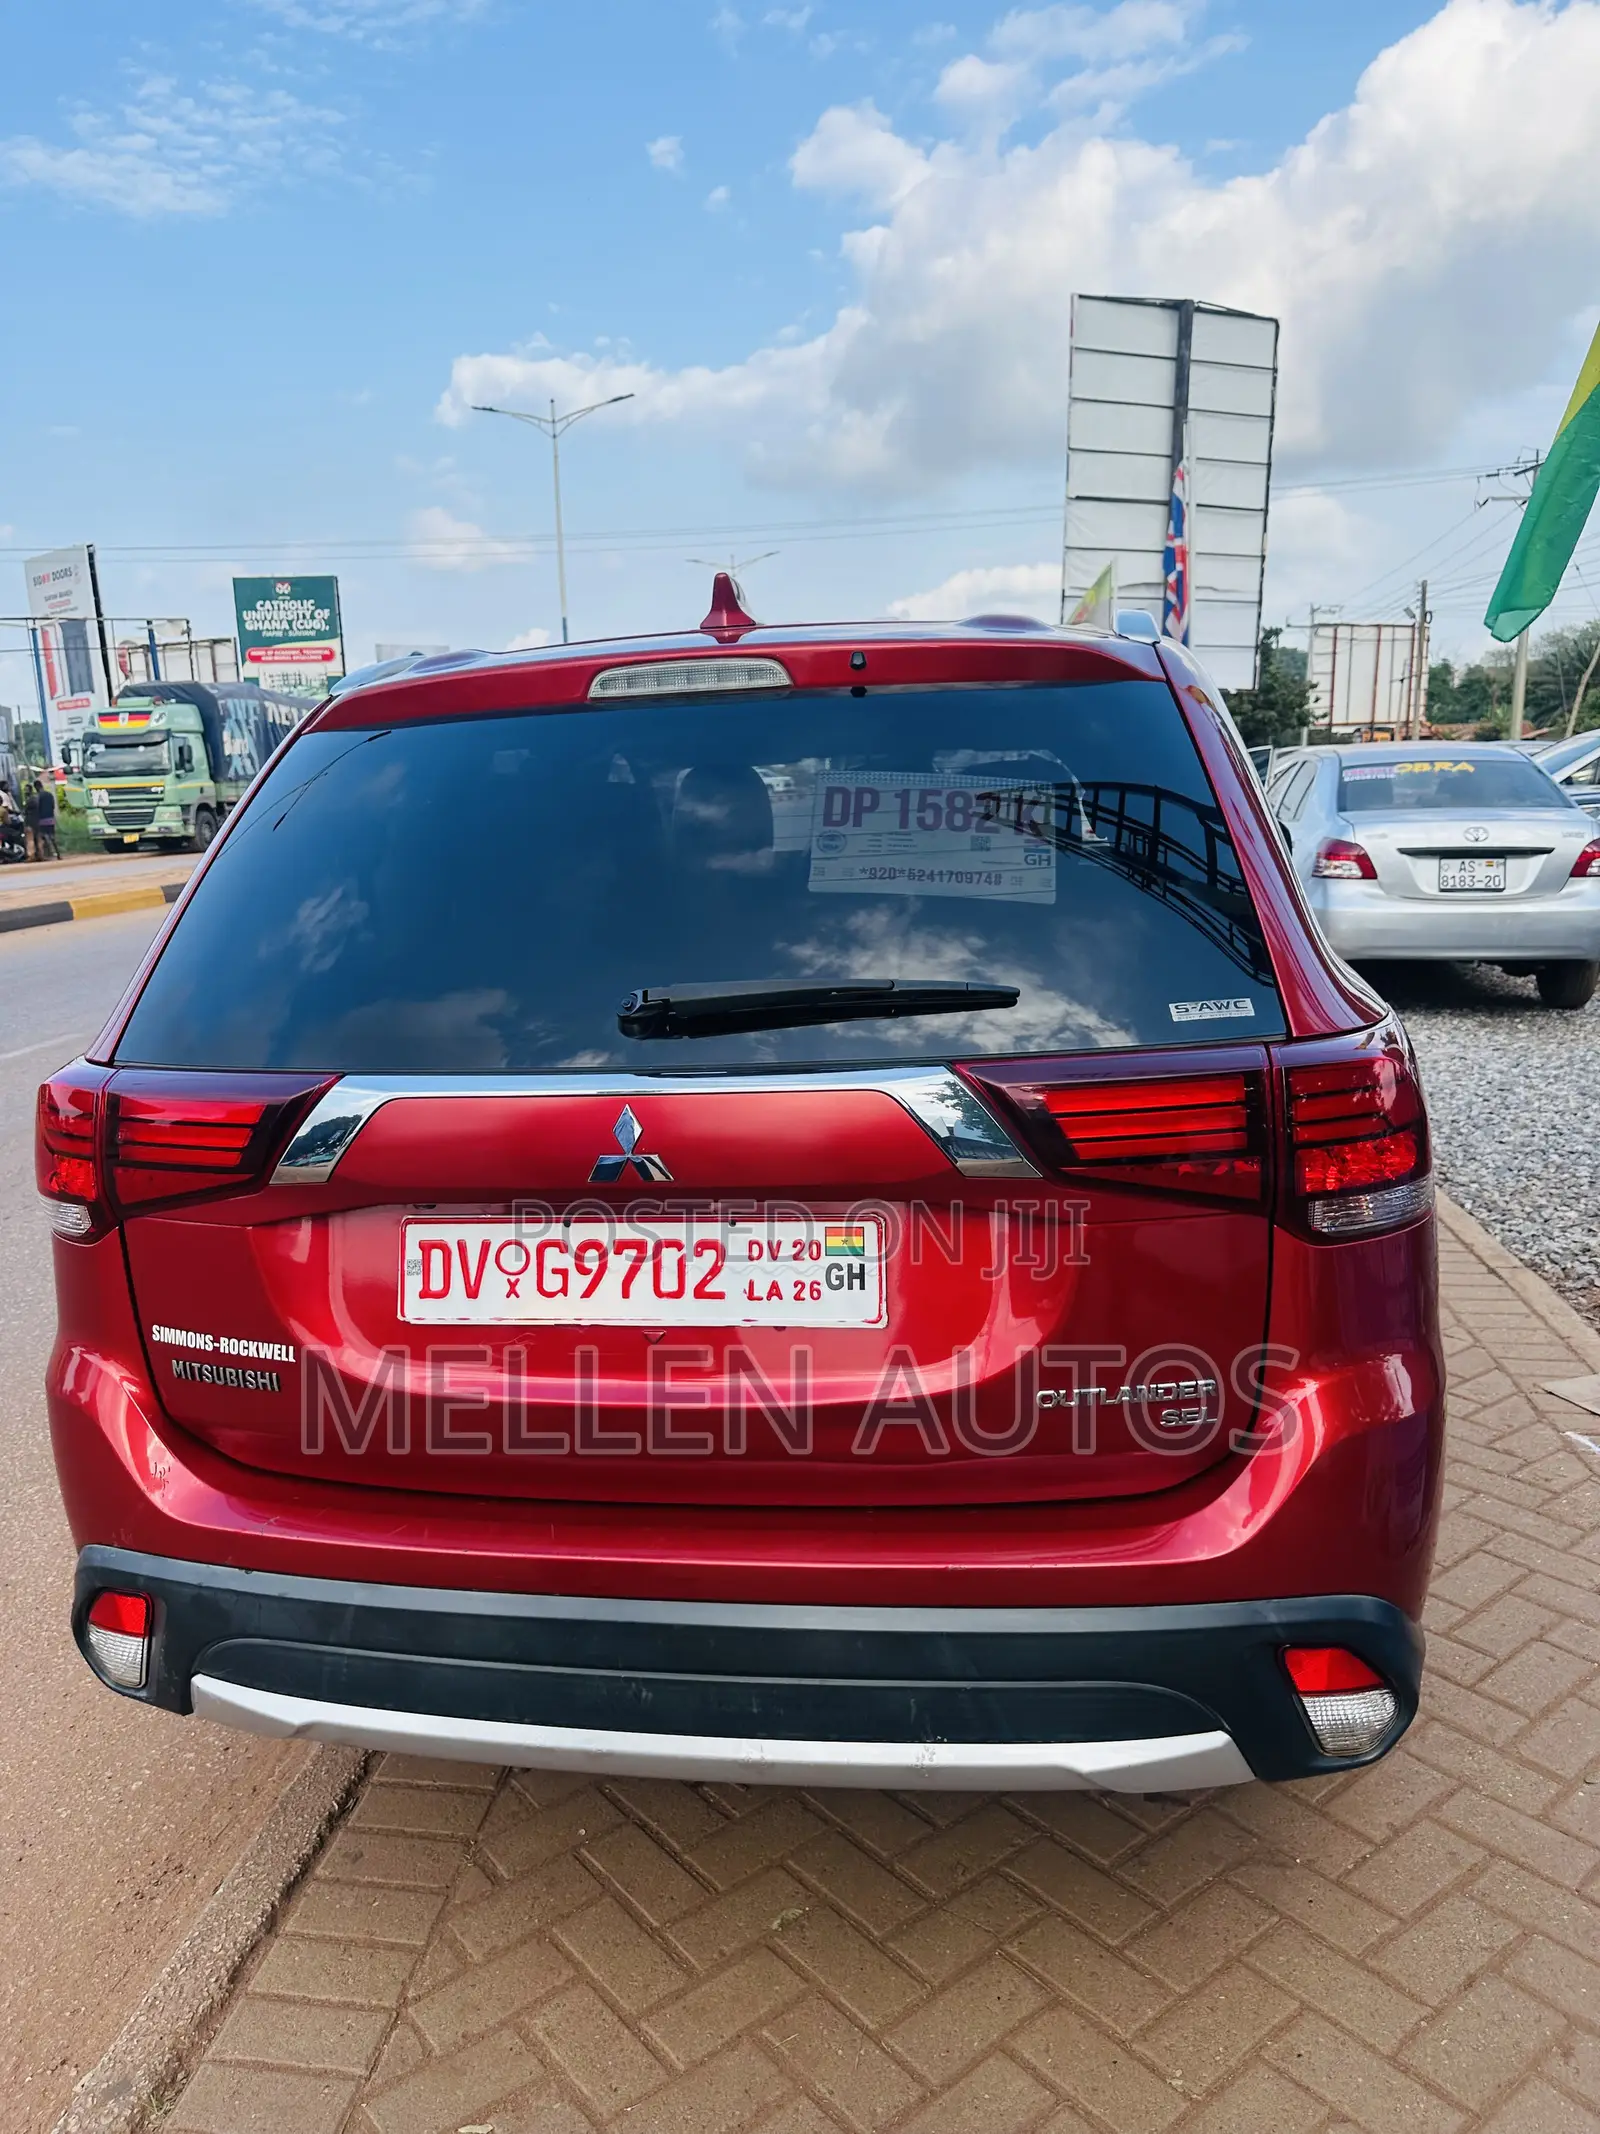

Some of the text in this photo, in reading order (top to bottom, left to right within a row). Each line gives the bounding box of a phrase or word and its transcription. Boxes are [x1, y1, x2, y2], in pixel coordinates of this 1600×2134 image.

[242, 608, 330, 620] UNIVERSITY OF
[256, 600, 315, 611] CATHOLIC
[245, 620, 290, 630] GHANA
[822, 785, 880, 828] DP
[893, 786, 1000, 834] 1582
[1023, 853, 1051, 866] GH
[1458, 860, 1476, 874] AS
[1441, 875, 1502, 888] 8183-20
[1174, 1000, 1249, 1014] S-AWC
[747, 1238, 822, 1262] DV 20
[418, 1238, 726, 1300] DV G9702
[825, 1262, 866, 1291] GH
[746, 1279, 822, 1302] LA 26
[152, 1324, 296, 1363] SIMMONS-ROCKWELL
[171, 1359, 280, 1392] MITSUBISHI
[1036, 1378, 1217, 1409] OUTLANDER
[1160, 1405, 1219, 1427] SEL
